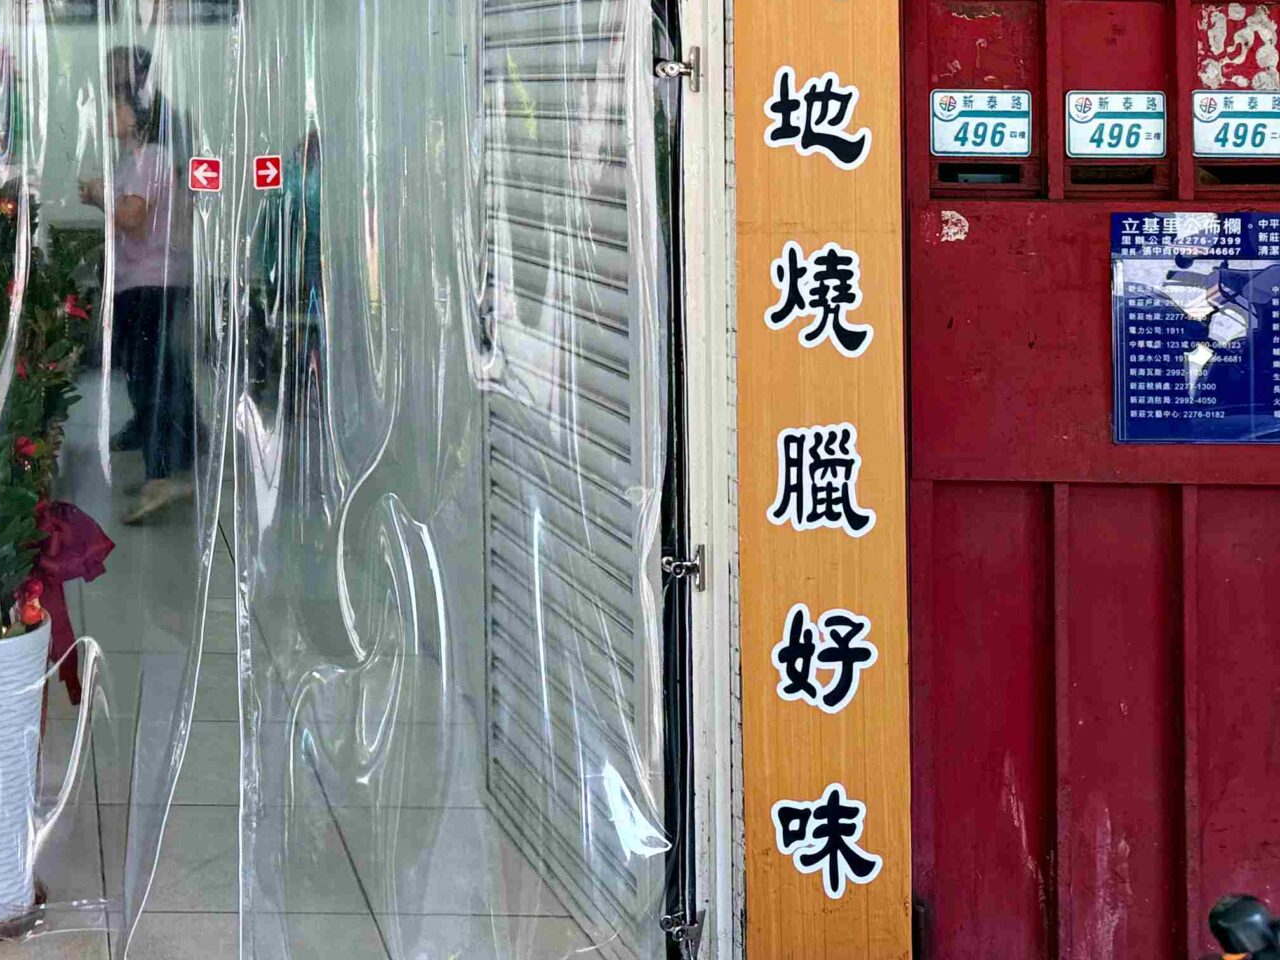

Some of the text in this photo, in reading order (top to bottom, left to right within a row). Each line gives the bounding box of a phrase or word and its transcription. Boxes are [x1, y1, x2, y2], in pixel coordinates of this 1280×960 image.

[962, 94, 1023, 110] 新泰路
[1097, 95, 1158, 111] 新泰路
[1223, 95, 1280, 110] 新泰路
[953, 121, 1008, 148] 496
[1088, 122, 1142, 149] 496
[1213, 121, 1268, 149] 496
[1166, 327, 1185, 335] 1911
[1166, 341, 1180, 349] 123
[1174, 396, 1217, 405] 2992-4050
[1183, 410, 1226, 419] 2276-0182
